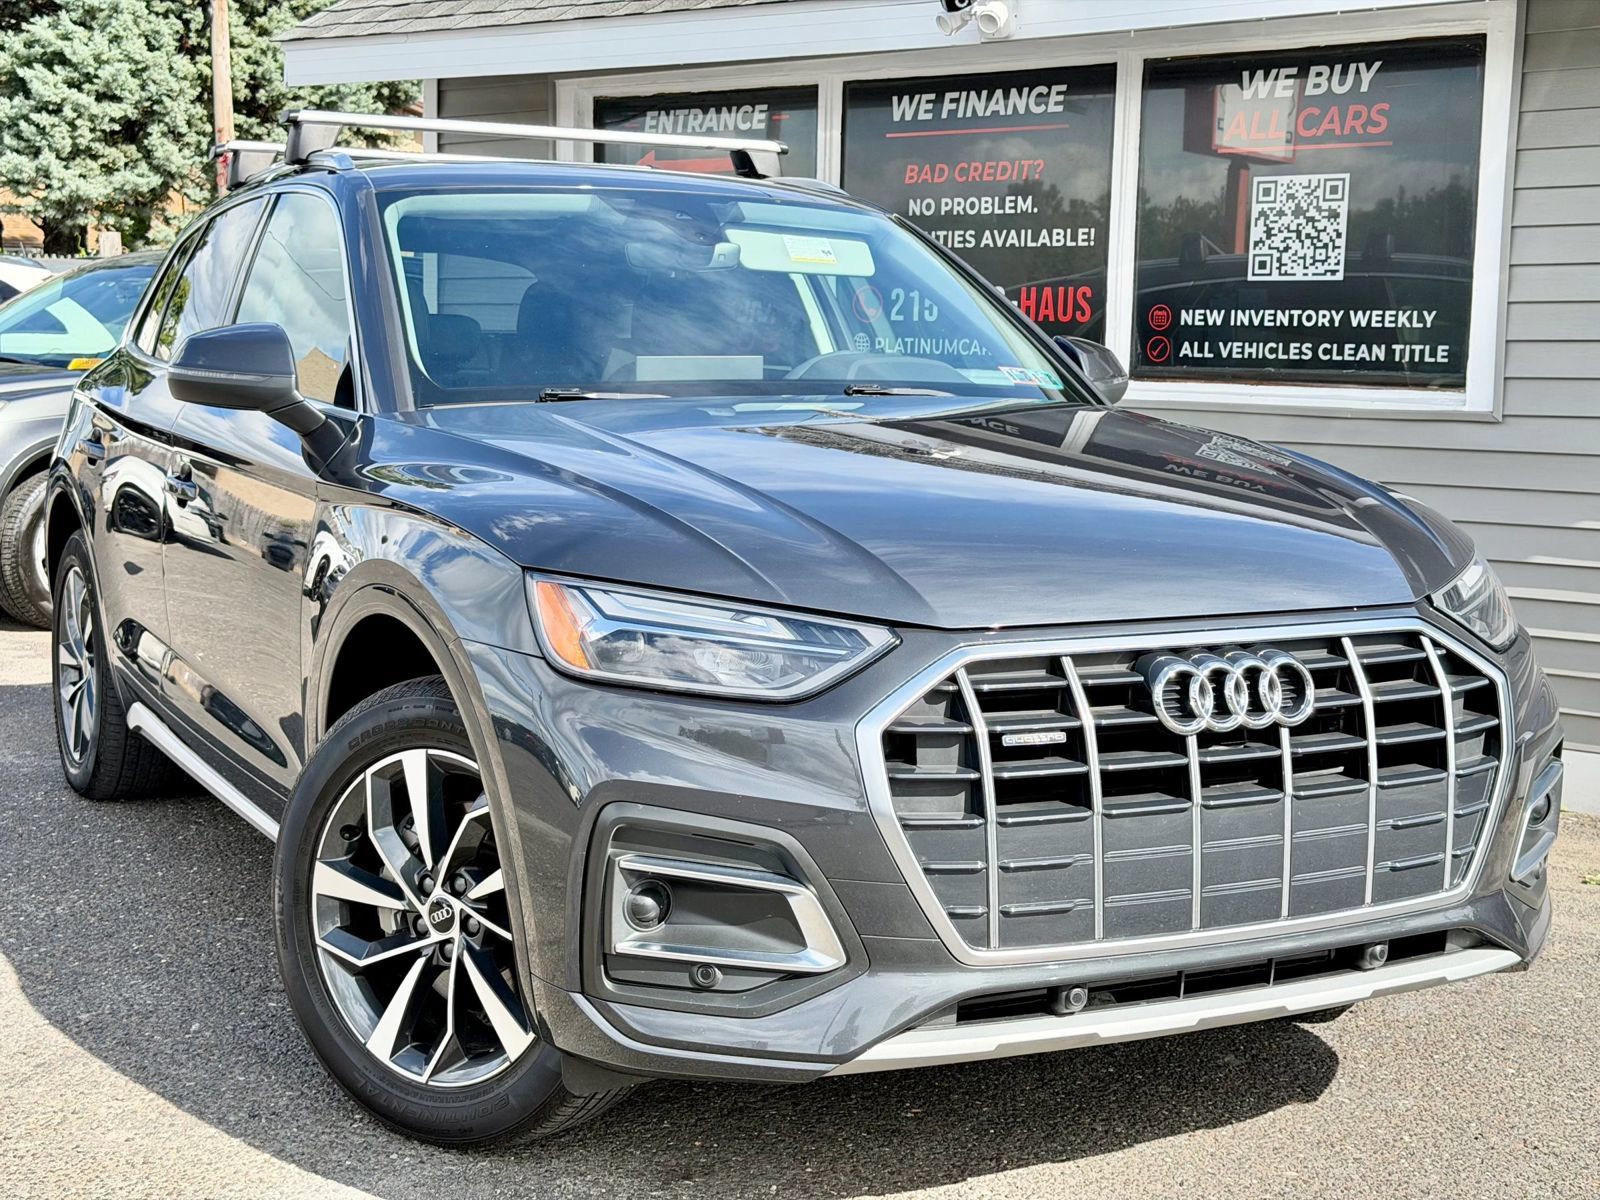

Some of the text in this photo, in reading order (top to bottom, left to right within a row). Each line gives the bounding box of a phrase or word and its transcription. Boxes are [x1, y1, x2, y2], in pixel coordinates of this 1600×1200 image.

[1242, 61, 1383, 100] WE BUY
[892, 84, 1067, 121] WE FINANCE
[644, 104, 768, 133] ENTRANCE
[1223, 103, 1391, 142] ALL CARS
[905, 159, 1045, 184] BAD CREDIT?
[908, 195, 1038, 216] NO PROBLEM.
[980, 228, 1096, 248] AVAILABLE!
[1180, 309, 1437, 328] NEW INVENTORY WEEKLY
[1179, 341, 1449, 363] ALL VEHICLES CLEAN TITLE
